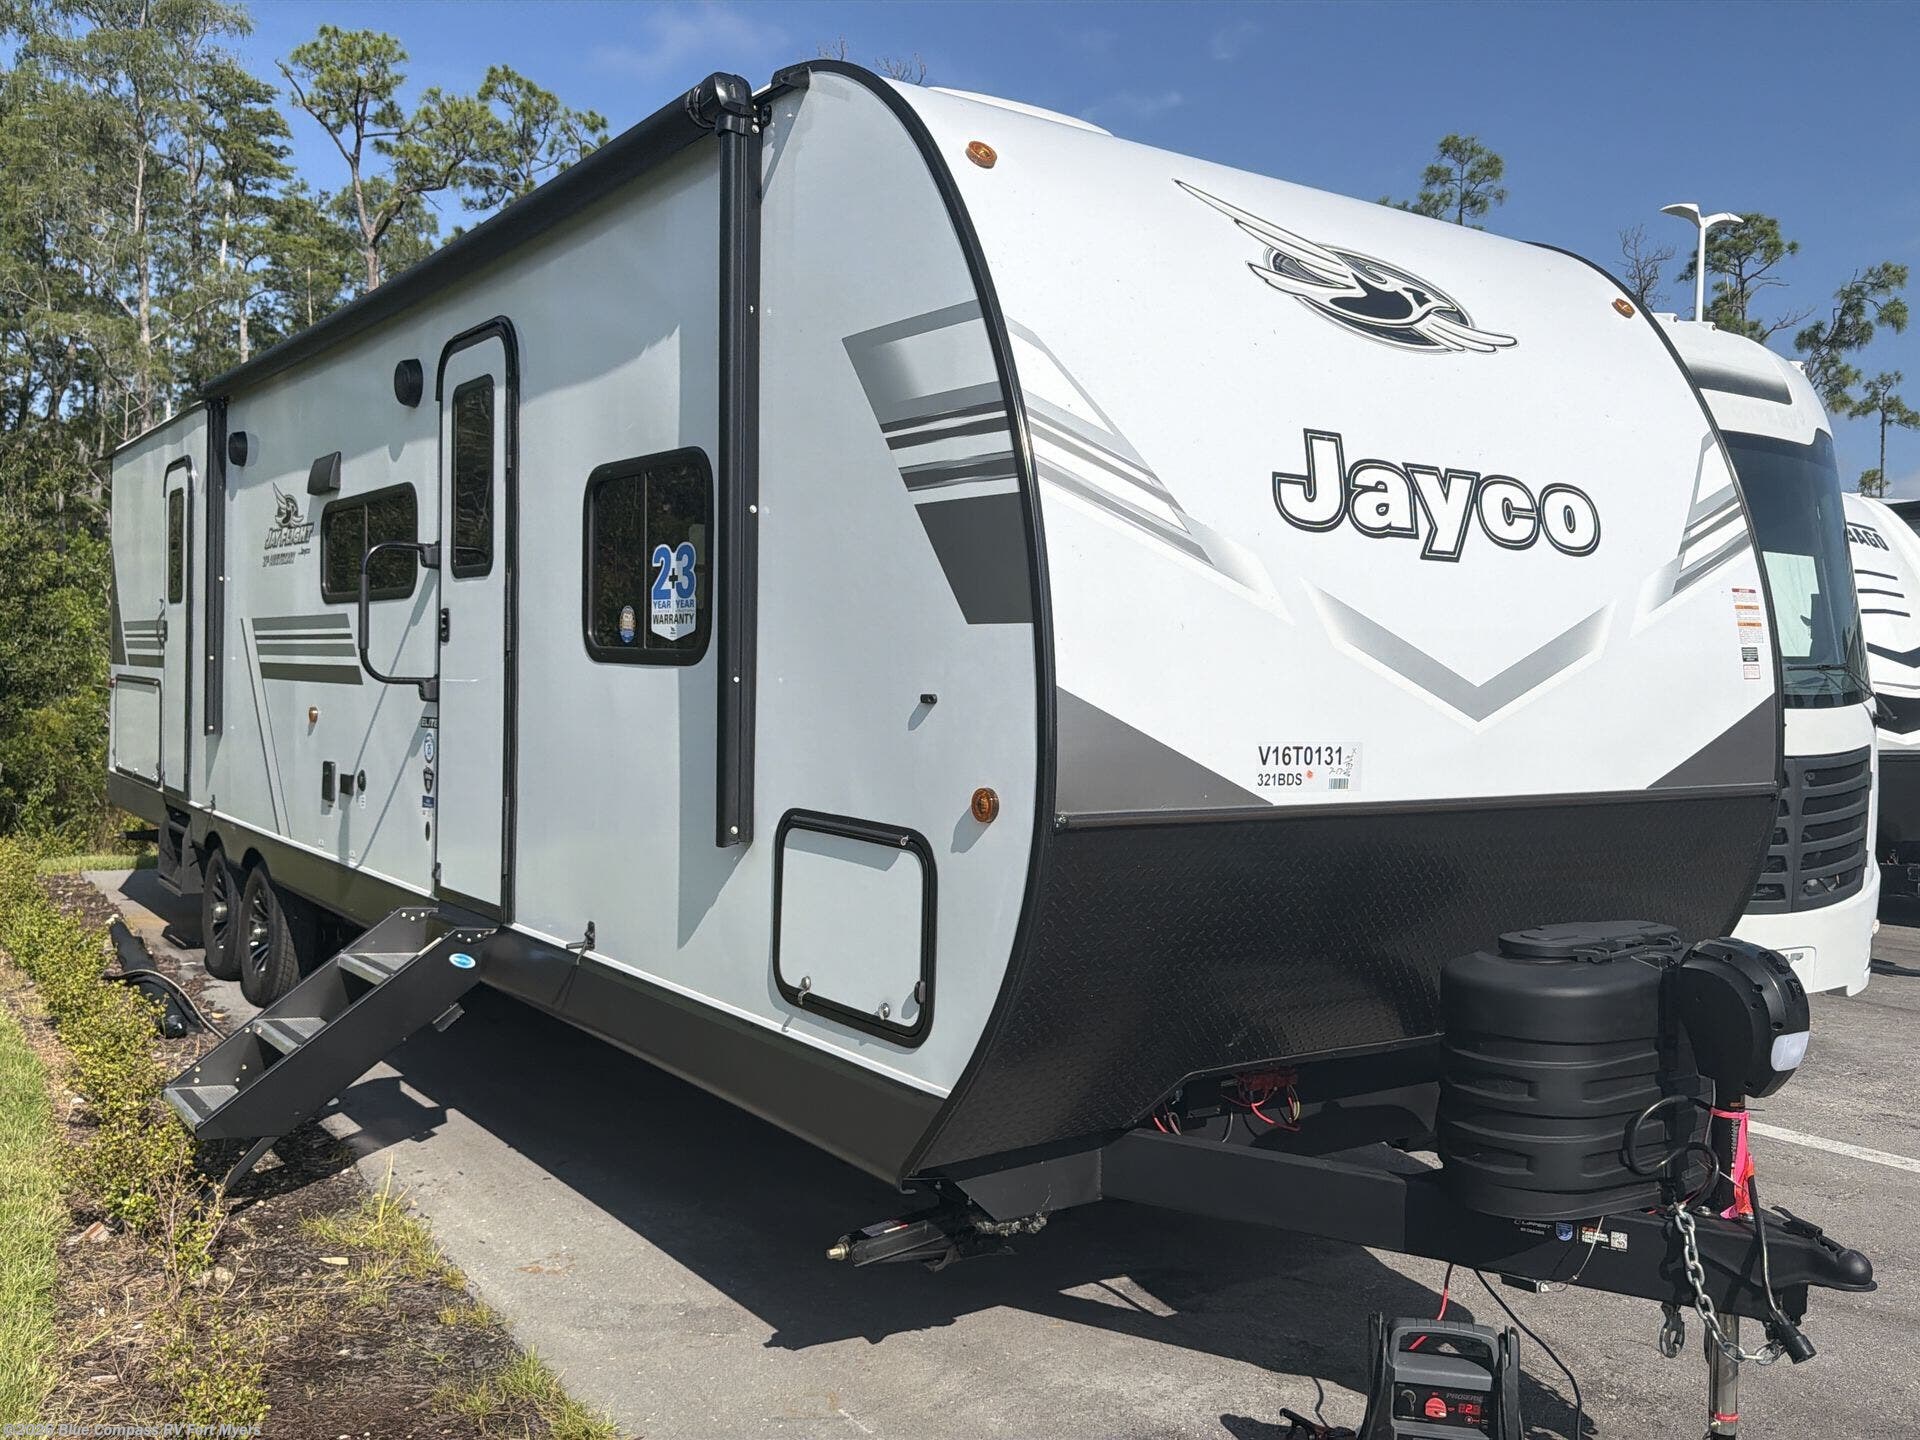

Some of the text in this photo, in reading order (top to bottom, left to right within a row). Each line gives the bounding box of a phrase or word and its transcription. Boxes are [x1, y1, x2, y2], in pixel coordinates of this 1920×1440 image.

[1272, 428, 1601, 563] Jayco
[653, 599, 695, 609] YEAR YEAR
[653, 614, 695, 625] WARRANTY
[1258, 746, 1342, 766] V16T0131
[1257, 773, 1303, 786] 321BDS
